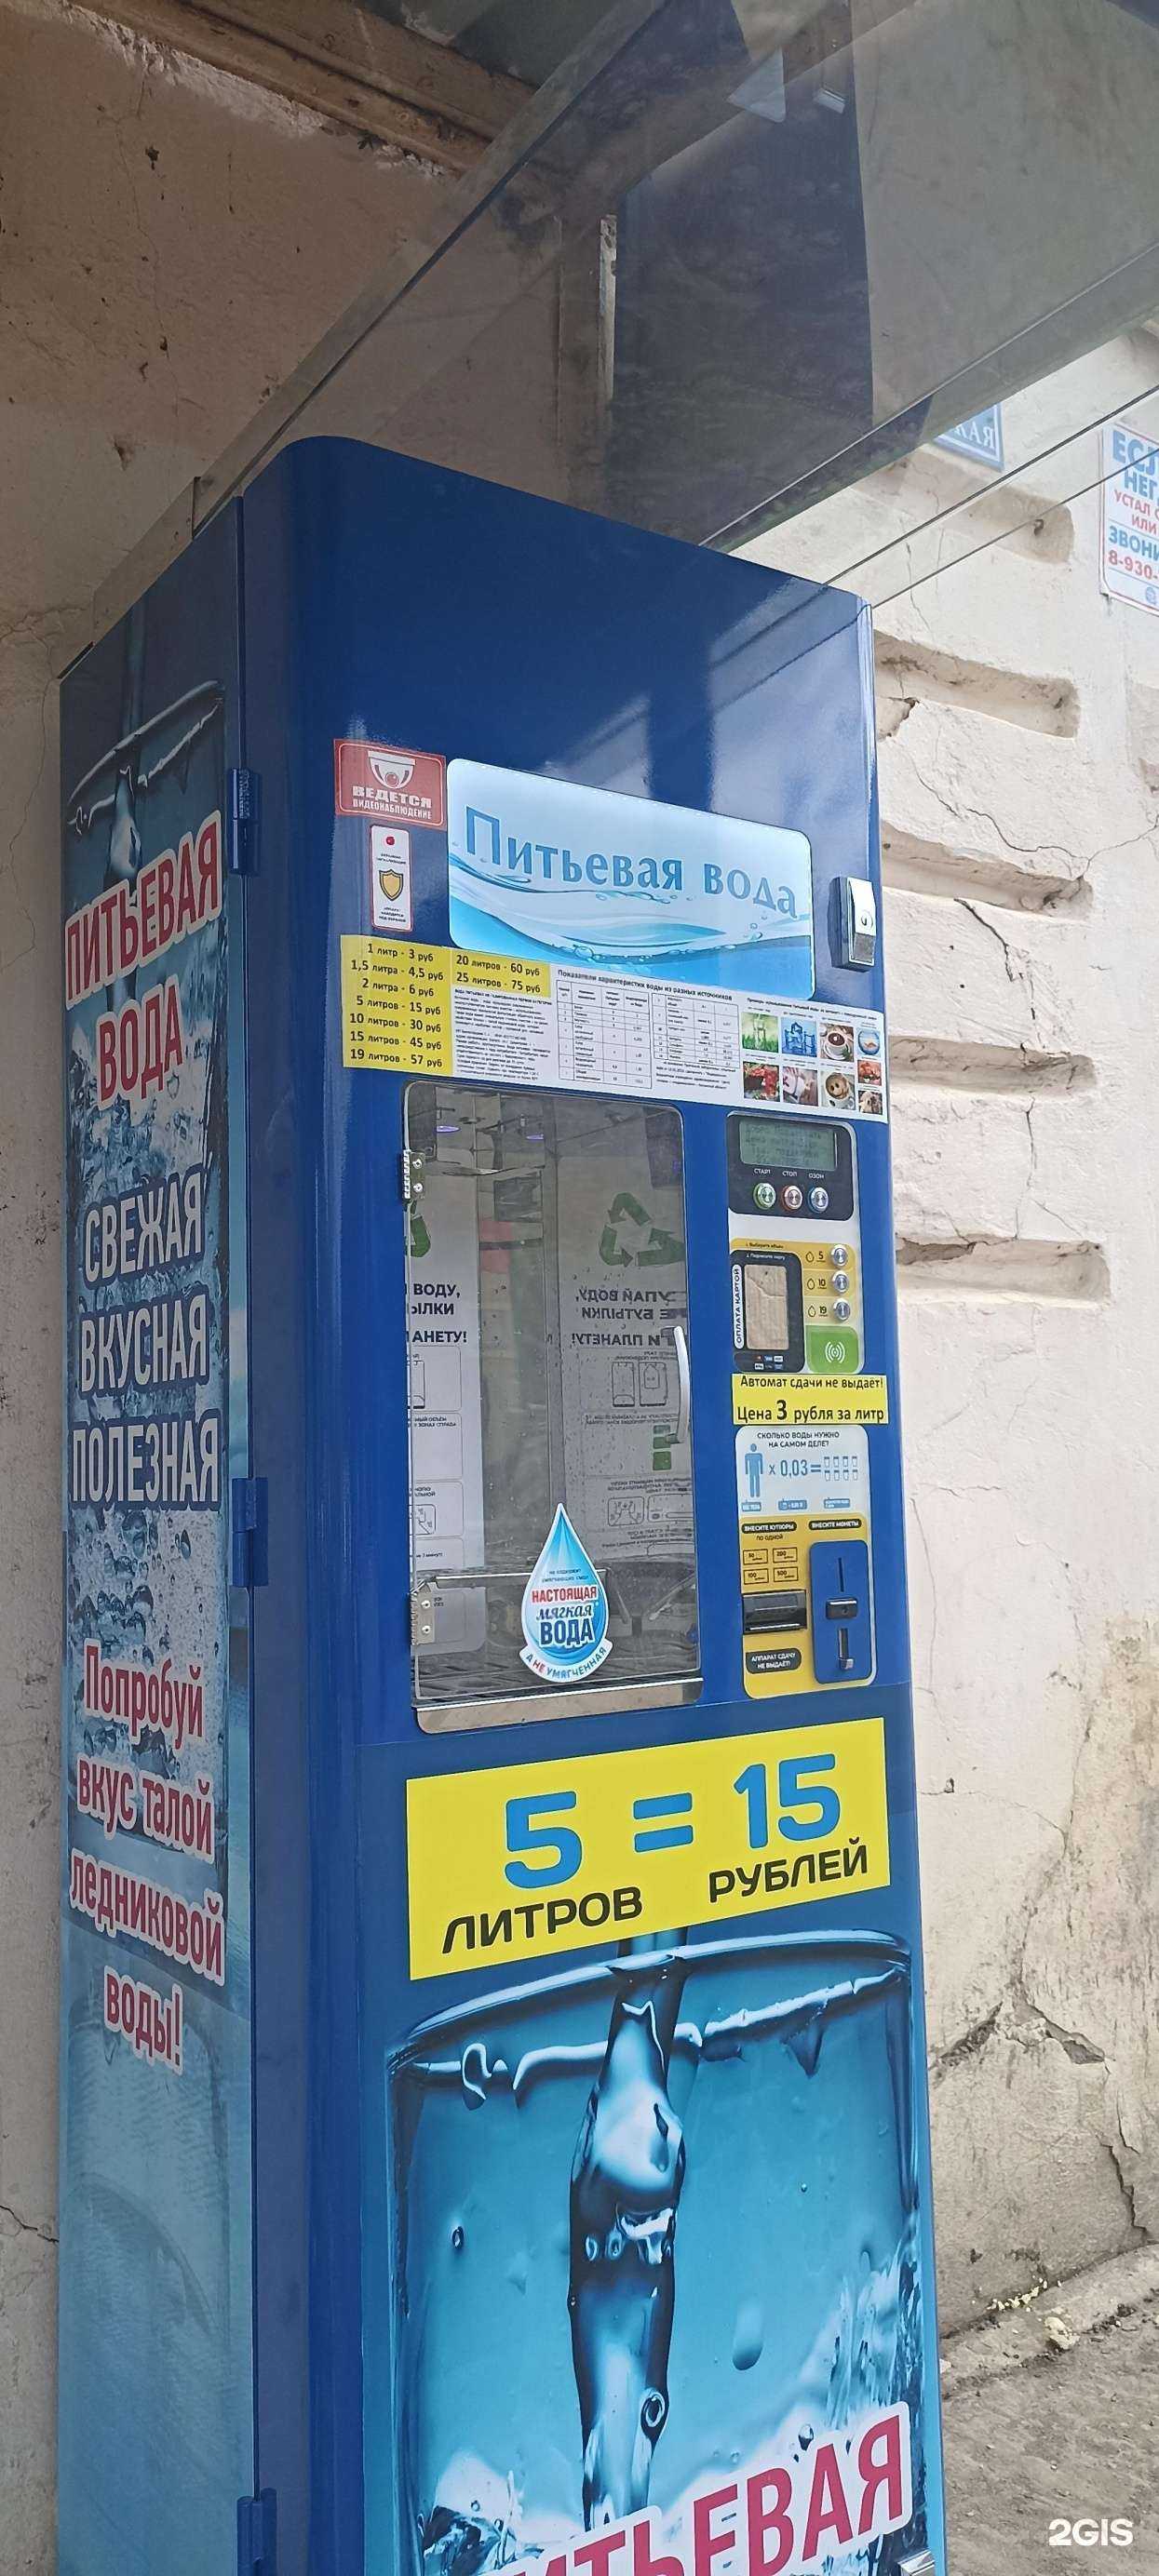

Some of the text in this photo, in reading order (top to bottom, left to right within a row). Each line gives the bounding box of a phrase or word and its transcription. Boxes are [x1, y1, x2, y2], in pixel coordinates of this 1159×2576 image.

[1125, 470, 1159, 506] НЕГ
[1114, 490, 1151, 517] УСТАЛ
[1132, 515, 1157, 535] ИЛИ
[353, 785, 432, 809] ВЕДЕТСЯ
[353, 798, 432, 820] ВИДЕОНАБЛЮДЕНИЕ
[465, 805, 798, 919] Питьевая вода
[66, 821, 220, 1002] ПИТЬЕВАЯ
[368, 944, 372, 954] 1
[377, 948, 398, 959] литр
[409, 949, 415, 959] 3
[418, 952, 433, 962] руб
[351, 959, 369, 972] 1,5
[372, 965, 398, 974] литра
[409, 967, 425, 979] 4,5
[428, 971, 444, 982] руб
[456, 955, 468, 965] 20
[471, 960, 501, 971] литров
[510, 963, 522, 973] 60
[525, 966, 540, 977] руб
[362, 978, 369, 988] 2
[372, 983, 398, 993] литра
[409, 985, 415, 995] 6
[418, 987, 434, 999] руб
[456, 973, 469, 983] 25
[472, 977, 501, 988] литров
[511, 980, 523, 990] 75
[526, 983, 540, 994] руб
[357, 996, 363, 1006] 5
[367, 1000, 398, 1011] литров
[410, 1002, 423, 1013] 15
[425, 1005, 441, 1017] руб
[350, 1013, 364, 1024] 10
[368, 1018, 398, 1028] литров
[410, 1020, 423, 1030] 30
[425, 1023, 441, 1034] руб
[99, 984, 183, 1103] ВОДА
[350, 1031, 364, 1041] 15
[368, 1036, 399, 1045] литров
[410, 1038, 424, 1048] 45
[426, 1040, 441, 1052] руб
[351, 1049, 364, 1059] 19
[369, 1053, 400, 1063] литров
[411, 1055, 424, 1066] 57
[427, 1058, 442, 1069] руб
[85, 1173, 204, 1282] СВЕЖАЯ
[818, 1251, 824, 1260] 5
[413, 1283, 461, 1298] ВОДУ,
[818, 1279, 827, 1287] 10
[819, 1306, 828, 1314] 19
[81, 1293, 208, 1393] ВКУСНАЯ
[411, 1330, 467, 1343] АНЕТУ!
[740, 1375, 788, 1388] Автомат
[790, 1377, 823, 1389] сдачи
[826, 1379, 838, 1388] не
[737, 1400, 884, 1424] Цена 3 рубля за литр
[757, 1431, 790, 1440] СКОЛЬКО
[792, 1431, 813, 1440] ВОДЫ
[780, 1440, 807, 1448] САМОМ
[808, 1440, 829, 1448] ДЕЛЕ?
[73, 1417, 219, 1503] ПОЛЕЗНАЯ
[780, 1459, 808, 1478] 0,03
[532, 1586, 598, 1603] НАСТОЯЩАЯ
[536, 1603, 592, 1621] мягкая
[540, 1617, 595, 1645] ВОДА
[526, 1646, 607, 1679] А НЕ УМЯГЧЕННАЯ
[751, 1654, 776, 1662] АППАРАТ
[86, 1644, 204, 1750] Попробуй
[78, 1758, 213, 1857] вкус талой
[504, 1790, 583, 1889] 5
[733, 1753, 841, 1849] 15
[708, 1835, 868, 1904] РУБЛЕЙ
[71, 1855, 222, 1977] ледниковой
[441, 1885, 643, 1954] ЛИТРОВ
[106, 1972, 182, 2067] воды!
